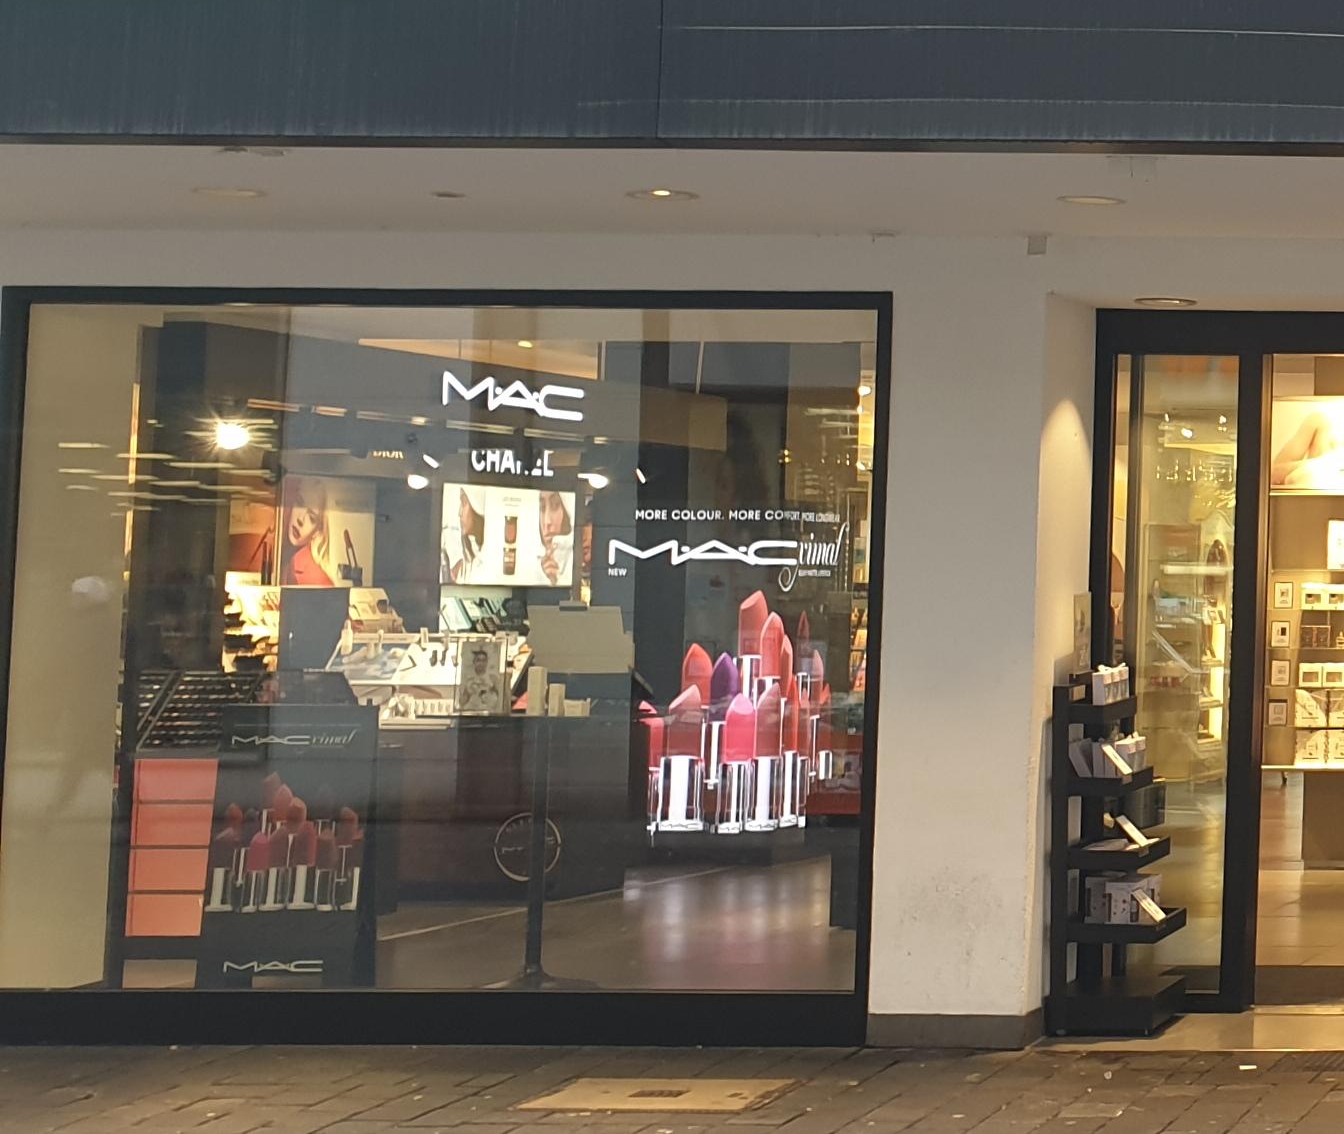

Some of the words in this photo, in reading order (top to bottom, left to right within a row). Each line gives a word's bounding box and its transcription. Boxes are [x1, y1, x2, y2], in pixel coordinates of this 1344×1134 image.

[471, 450, 554, 476] CHAL
[635, 510, 667, 521] MORE
[671, 510, 725, 521] COLOUR.
[729, 510, 761, 521] MORE
[608, 568, 628, 577] NEW
